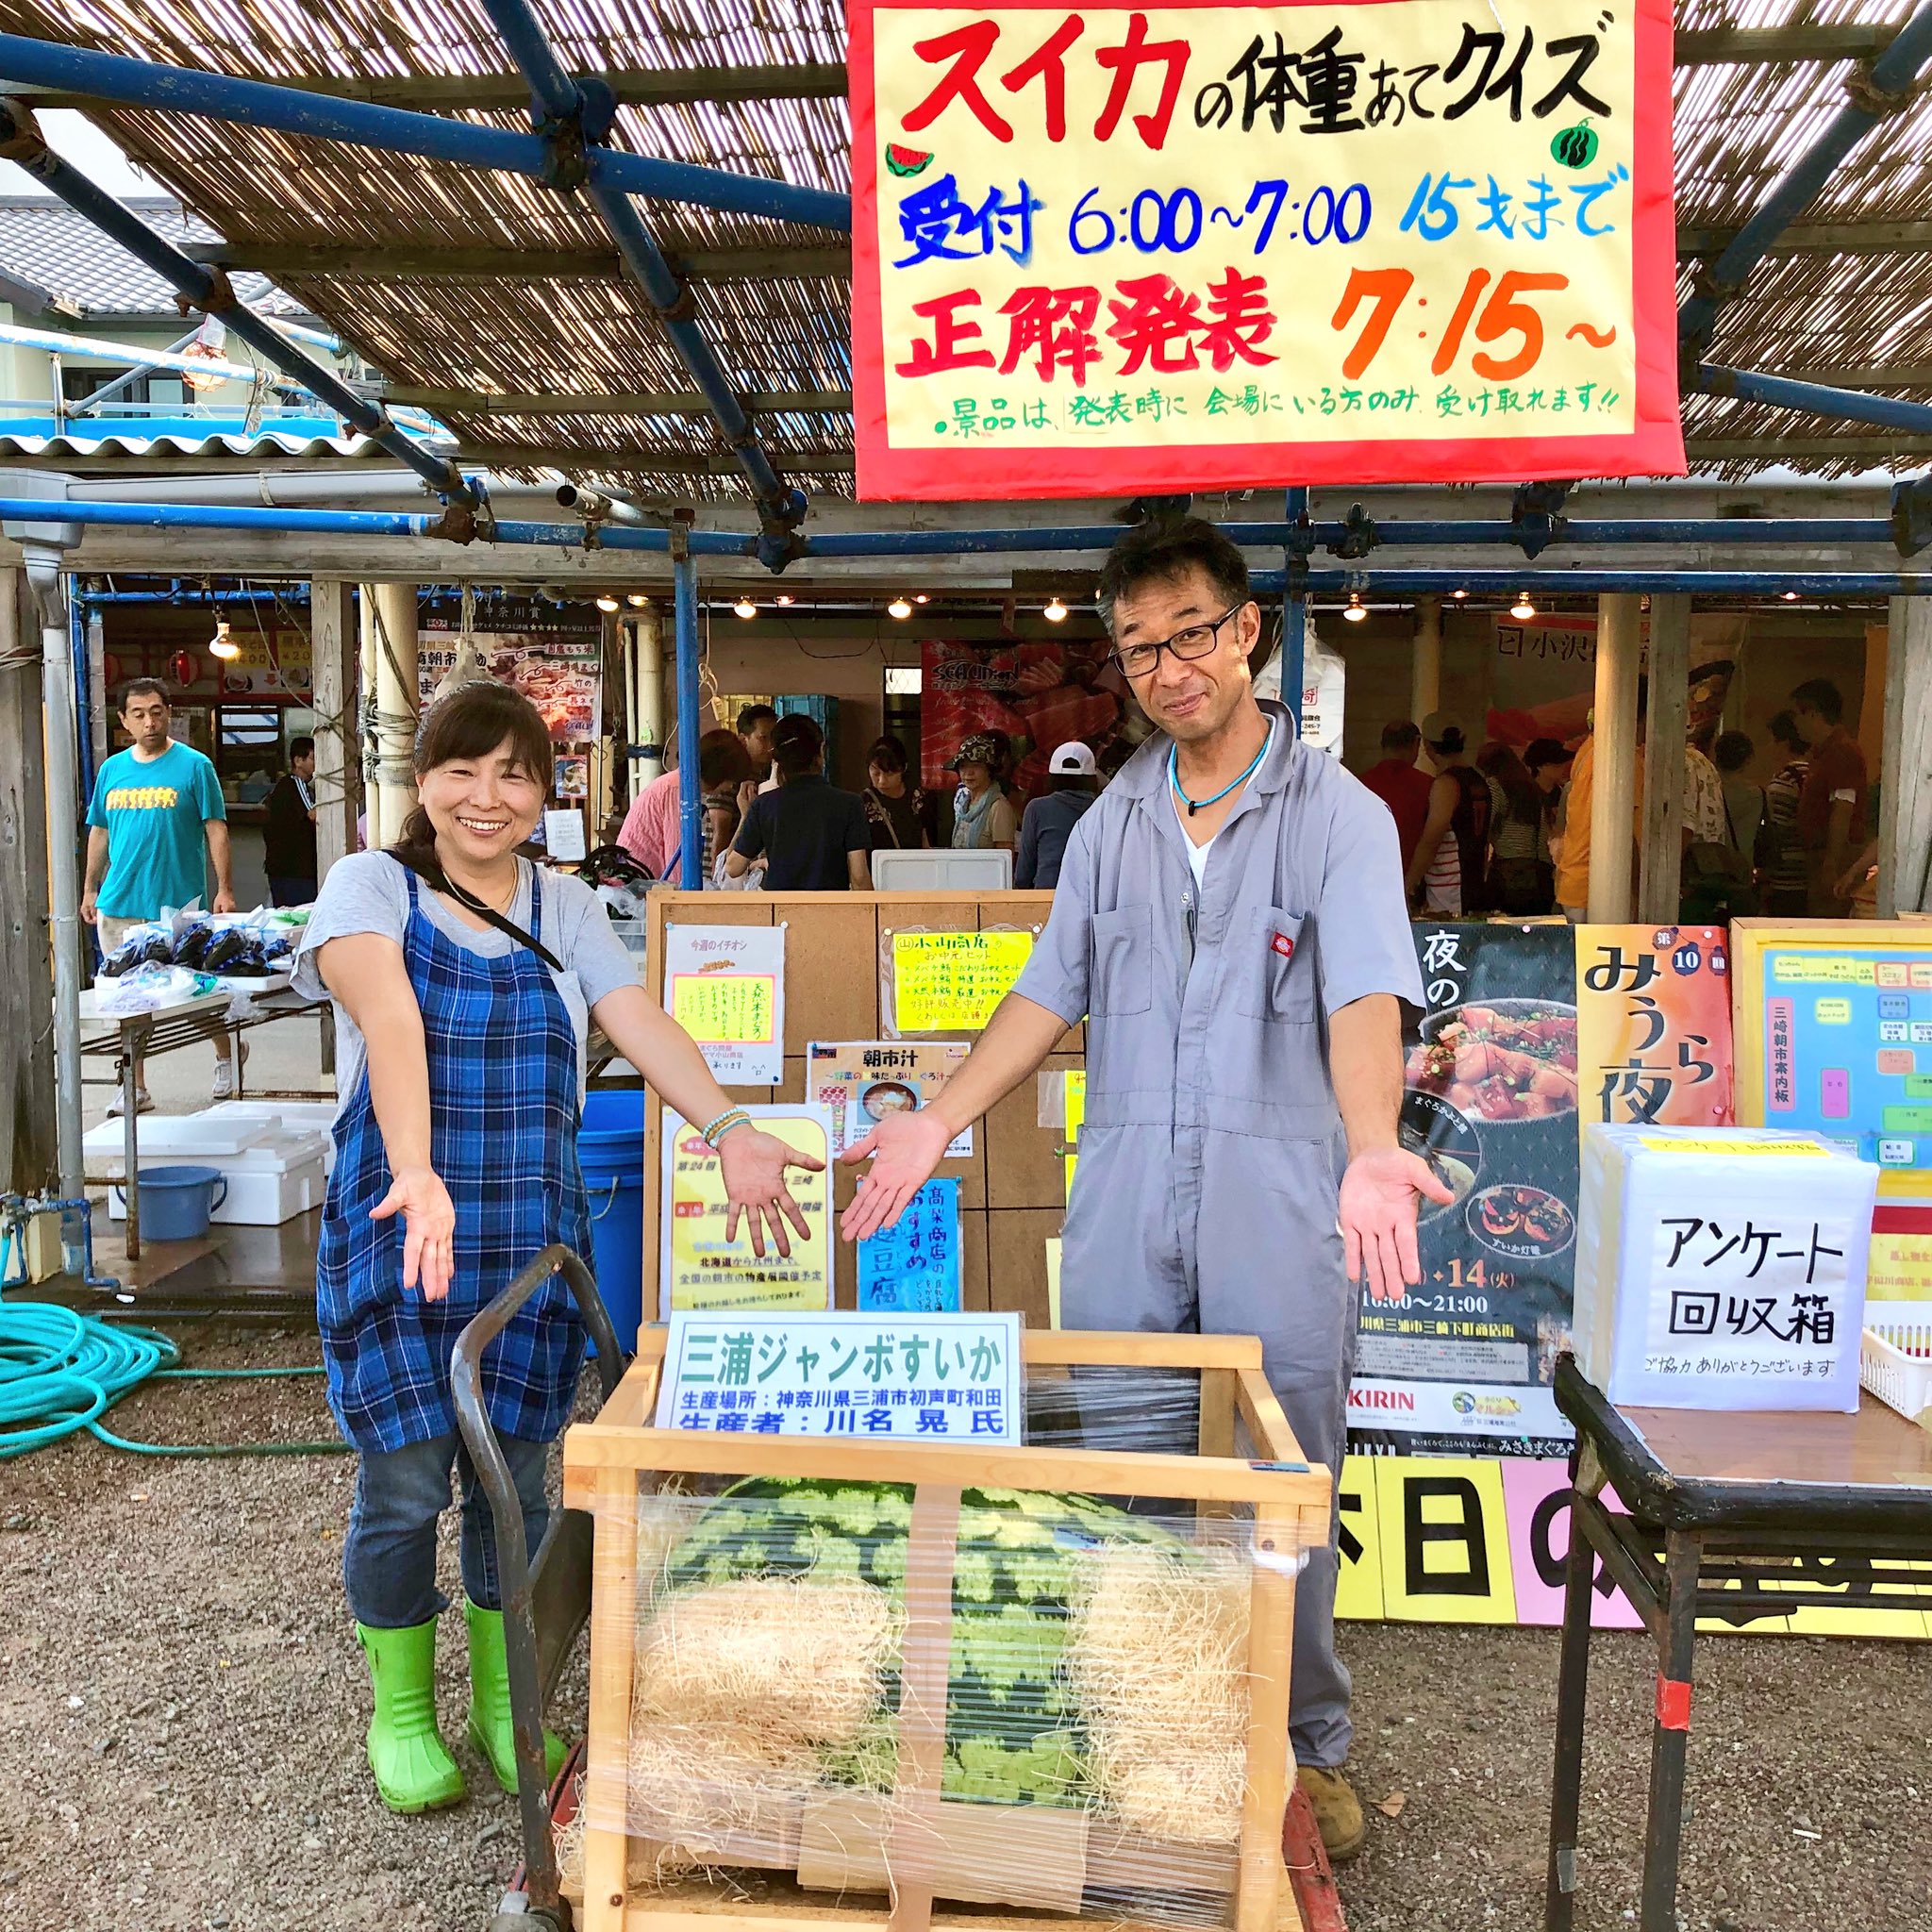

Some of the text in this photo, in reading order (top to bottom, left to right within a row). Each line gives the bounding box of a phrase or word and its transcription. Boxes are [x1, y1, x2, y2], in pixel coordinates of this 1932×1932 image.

[901, 10, 1614, 150] スイカの体重あてクイズ
[892, 173, 1045, 269] 受付
[894, 266, 1281, 388] 正解発表
[1423, 929, 1467, 1007] 夜の
[863, 1049, 919, 1068] 朝市汁
[1774, 1006, 1790, 1103] 三崎朝市案内板
[1661, 1218, 1843, 1284] アンケート
[1669, 1291, 1834, 1344] 回収箱
[681, 1332, 1001, 1386] 三浦ジャンボすいか
[1348, 1389, 1415, 1411] KIRIN
